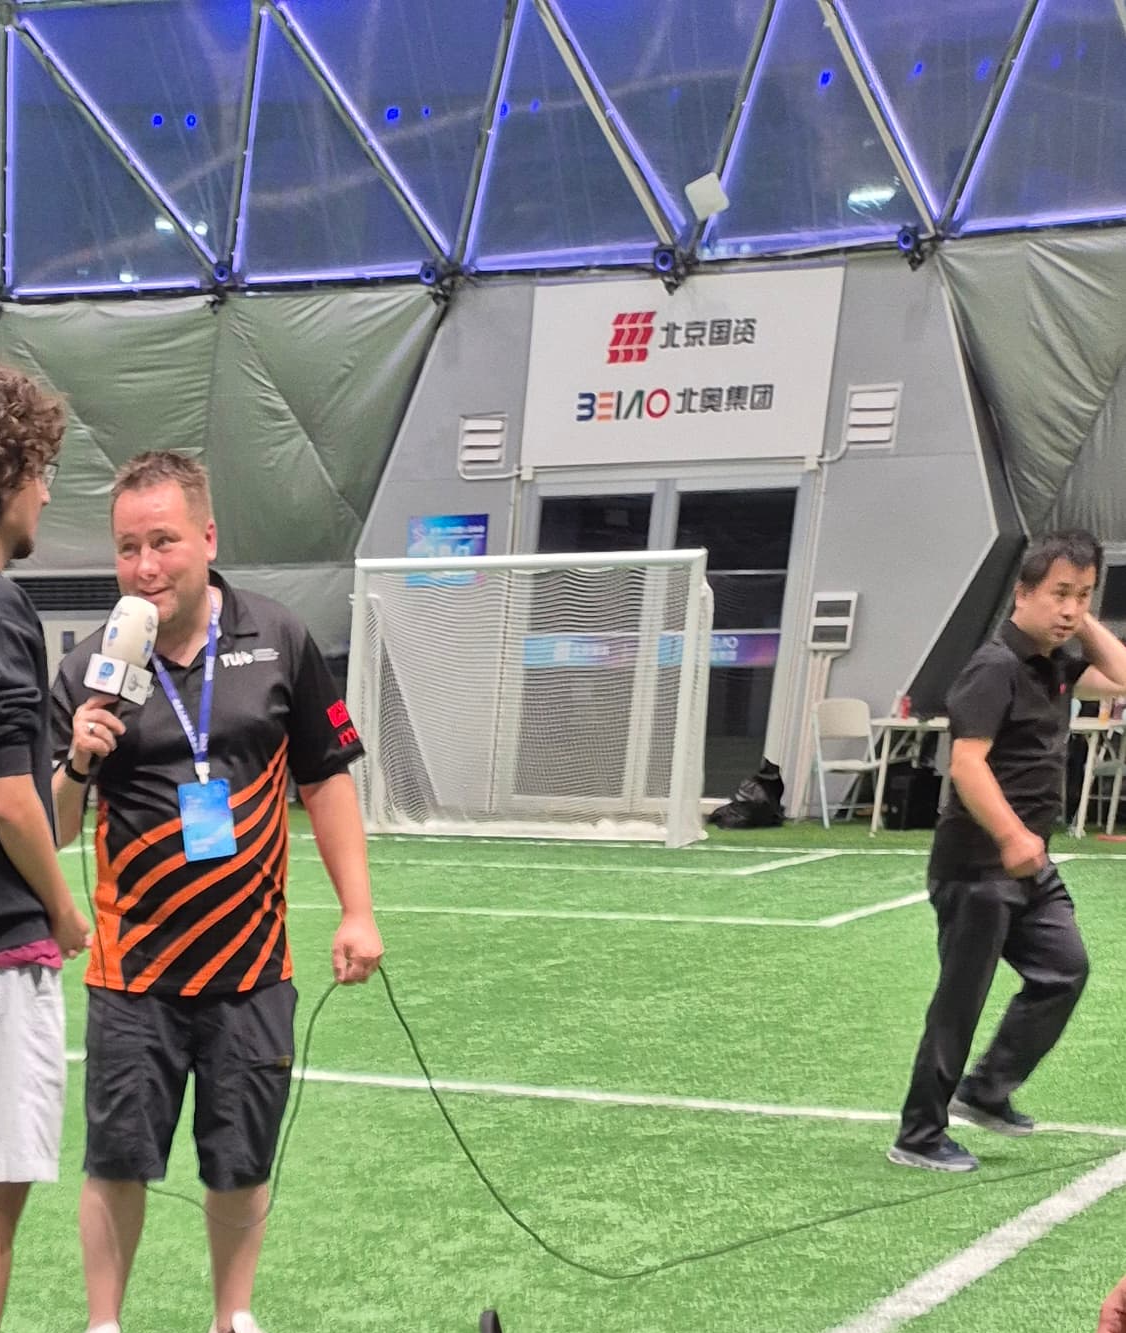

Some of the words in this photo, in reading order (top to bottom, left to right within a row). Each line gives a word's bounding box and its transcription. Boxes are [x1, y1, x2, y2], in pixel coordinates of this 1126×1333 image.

[659, 318, 757, 349] 北京国资
[675, 383, 774, 414] 北奥集团
